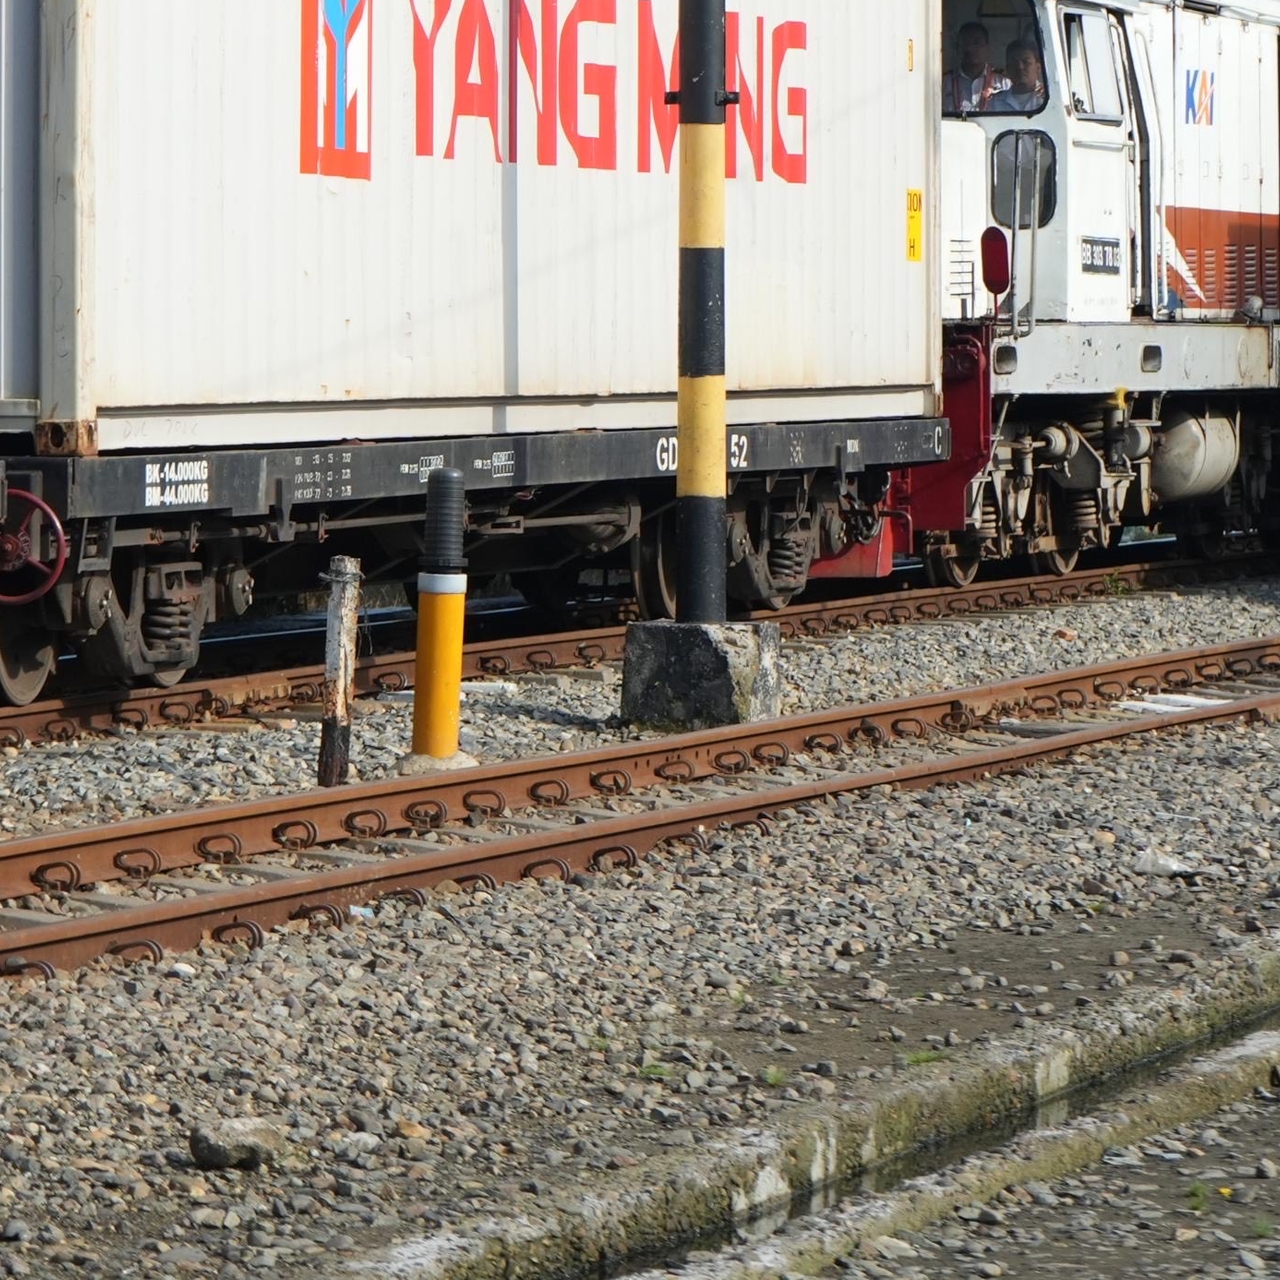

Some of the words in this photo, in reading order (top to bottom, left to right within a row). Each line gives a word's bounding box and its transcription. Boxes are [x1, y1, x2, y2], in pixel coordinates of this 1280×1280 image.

[1185, 69, 1215, 126] KAI
[1081, 242, 1092, 265] BB
[730, 434, 748, 468] 52
[934, 426, 942, 455] C
